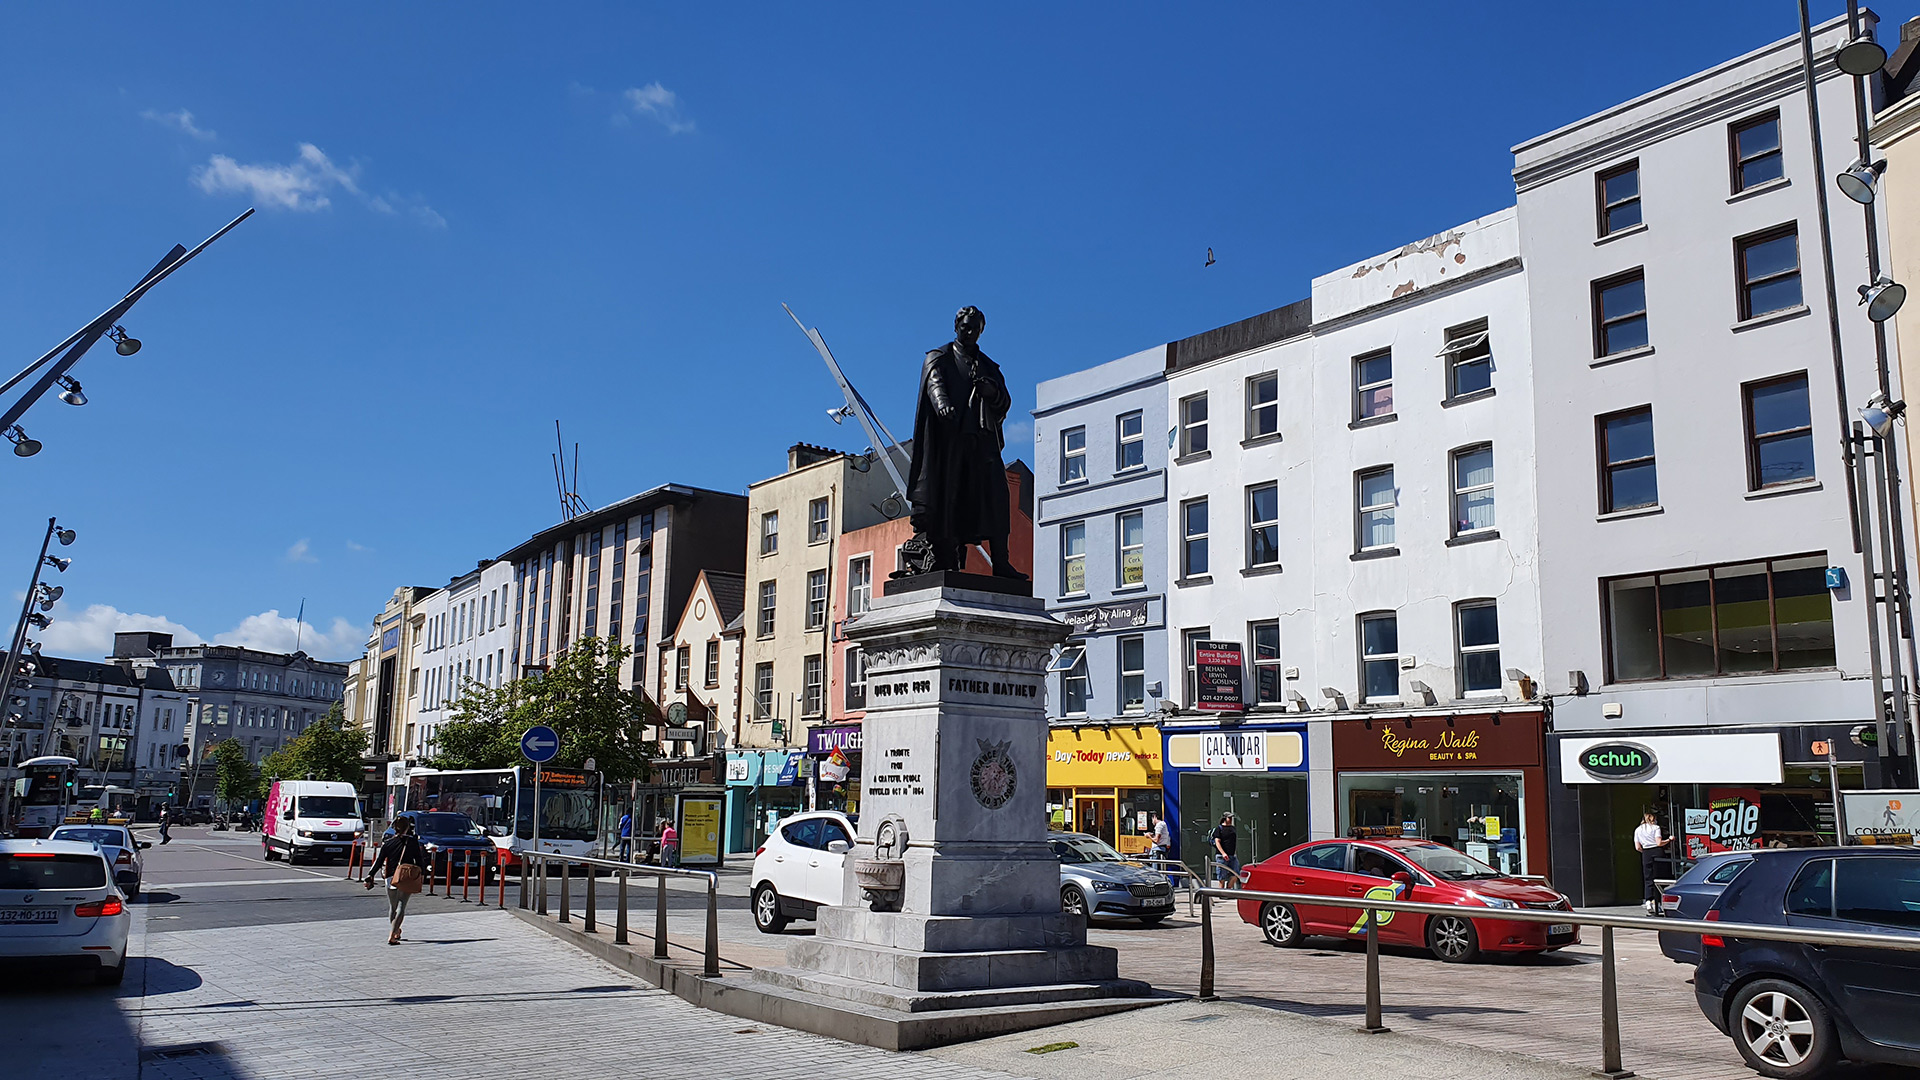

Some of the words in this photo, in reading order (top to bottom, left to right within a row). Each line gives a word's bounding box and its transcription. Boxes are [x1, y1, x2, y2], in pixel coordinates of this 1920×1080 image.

[1100, 611, 1108, 621] by
[1110, 609, 1131, 618] Alina
[1202, 672, 1211, 684] &
[874, 684, 892, 697] DIED
[949, 679, 989, 694] FATHER
[993, 682, 1037, 699] MATHEW
[1206, 736, 1260, 756] CALENDAR
[1382, 733, 1430, 757] Regina
[1434, 730, 1480, 749] Nails
[1055, 750, 1104, 764] Day-Today
[1106, 752, 1131, 761] news
[1588, 751, 1642, 766] schuh
[661, 768, 700, 784] MICHEL
[1711, 798, 1740, 809] summer
[1710, 800, 1759, 840] sale
[1732, 836, 1750, 850] 75%
